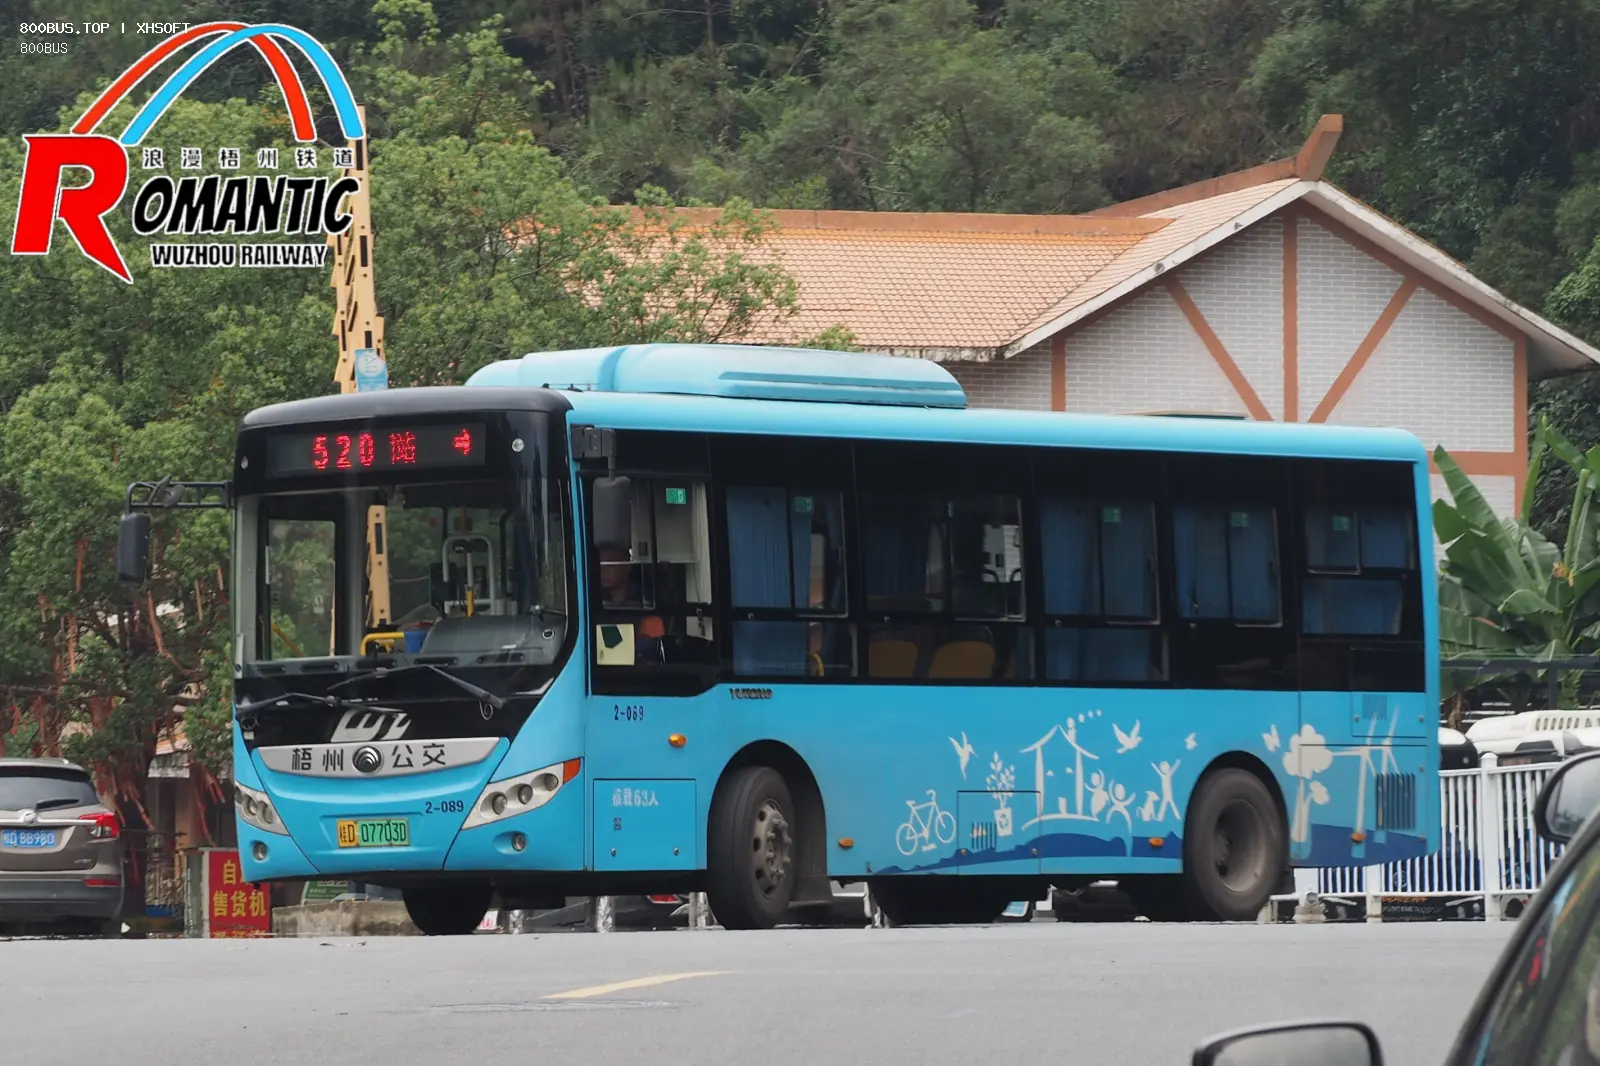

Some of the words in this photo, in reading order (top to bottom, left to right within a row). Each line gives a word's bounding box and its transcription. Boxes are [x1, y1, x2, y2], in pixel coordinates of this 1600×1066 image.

[313, 433, 374, 470] 520
[291, 747, 344, 772] 梧州
[391, 742, 446, 769] 公交
[425, 800, 465, 814] 2-089
[213, 889, 266, 917] 售货机
